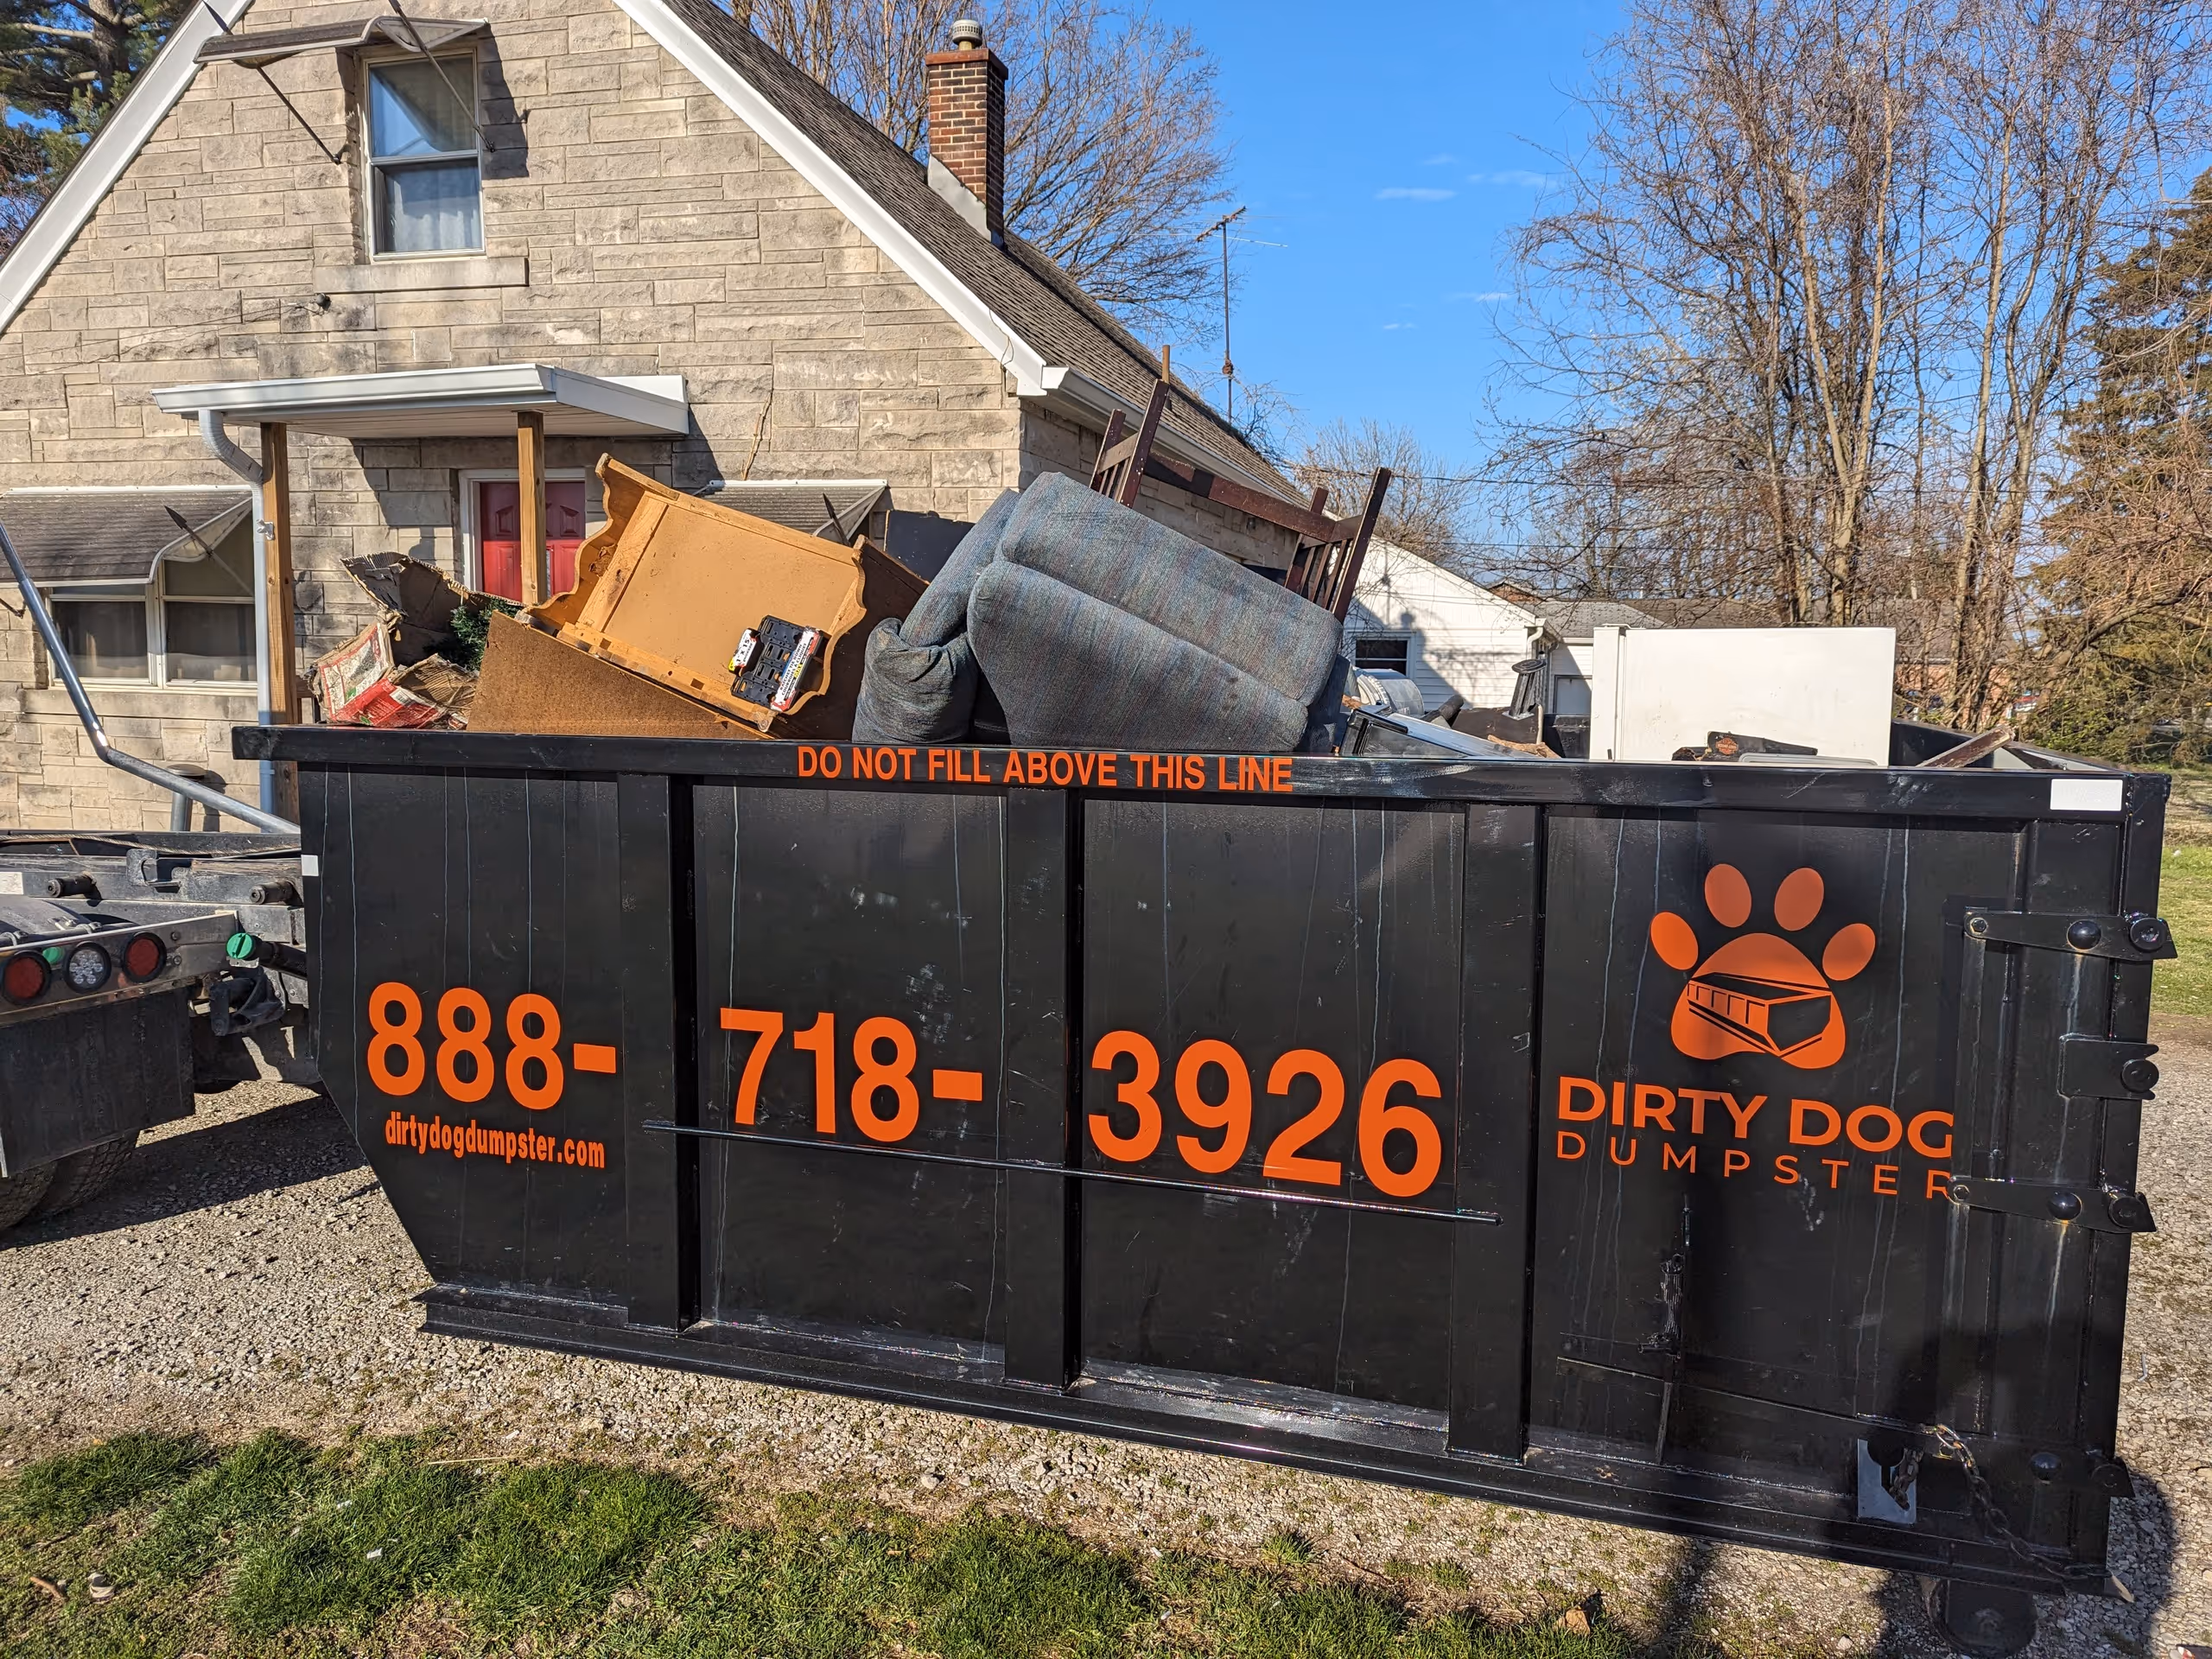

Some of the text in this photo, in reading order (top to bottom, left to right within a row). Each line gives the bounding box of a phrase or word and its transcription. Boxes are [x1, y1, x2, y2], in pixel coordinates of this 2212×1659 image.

[780, 669, 791, 691] RATCHET
[793, 644, 803, 660] DOWN
[798, 746, 1294, 792] DO NOT FILL ABOVE THIS LINE
[366, 982, 1442, 1198] 888- 718- 3926
[1558, 1076, 1955, 1159] DIRTY DOG
[385, 1110, 605, 1168] dirtydogdumpster.com
[1557, 1130, 1951, 1199] DUMPSTER
